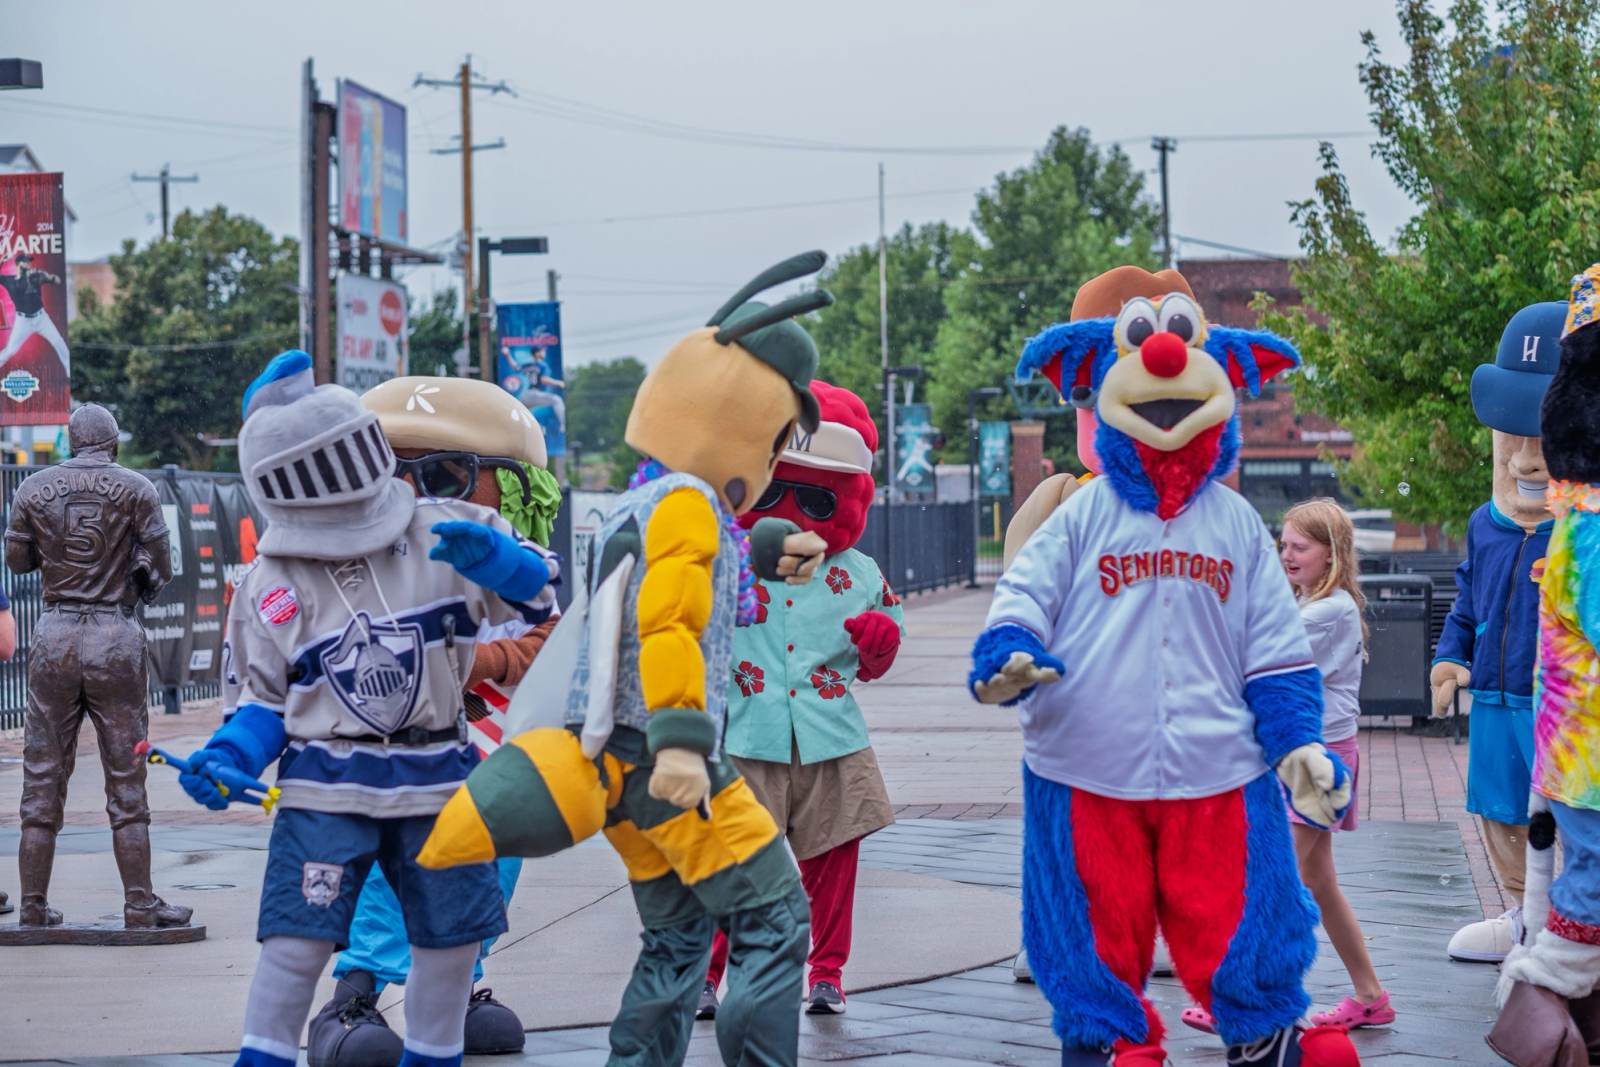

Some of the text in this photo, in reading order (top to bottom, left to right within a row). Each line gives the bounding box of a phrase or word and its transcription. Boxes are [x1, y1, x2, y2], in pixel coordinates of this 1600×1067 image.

[37, 222, 53, 232] 2014
[1522, 335, 1541, 362] H
[787, 427, 811, 452] M
[64, 500, 108, 568] 5
